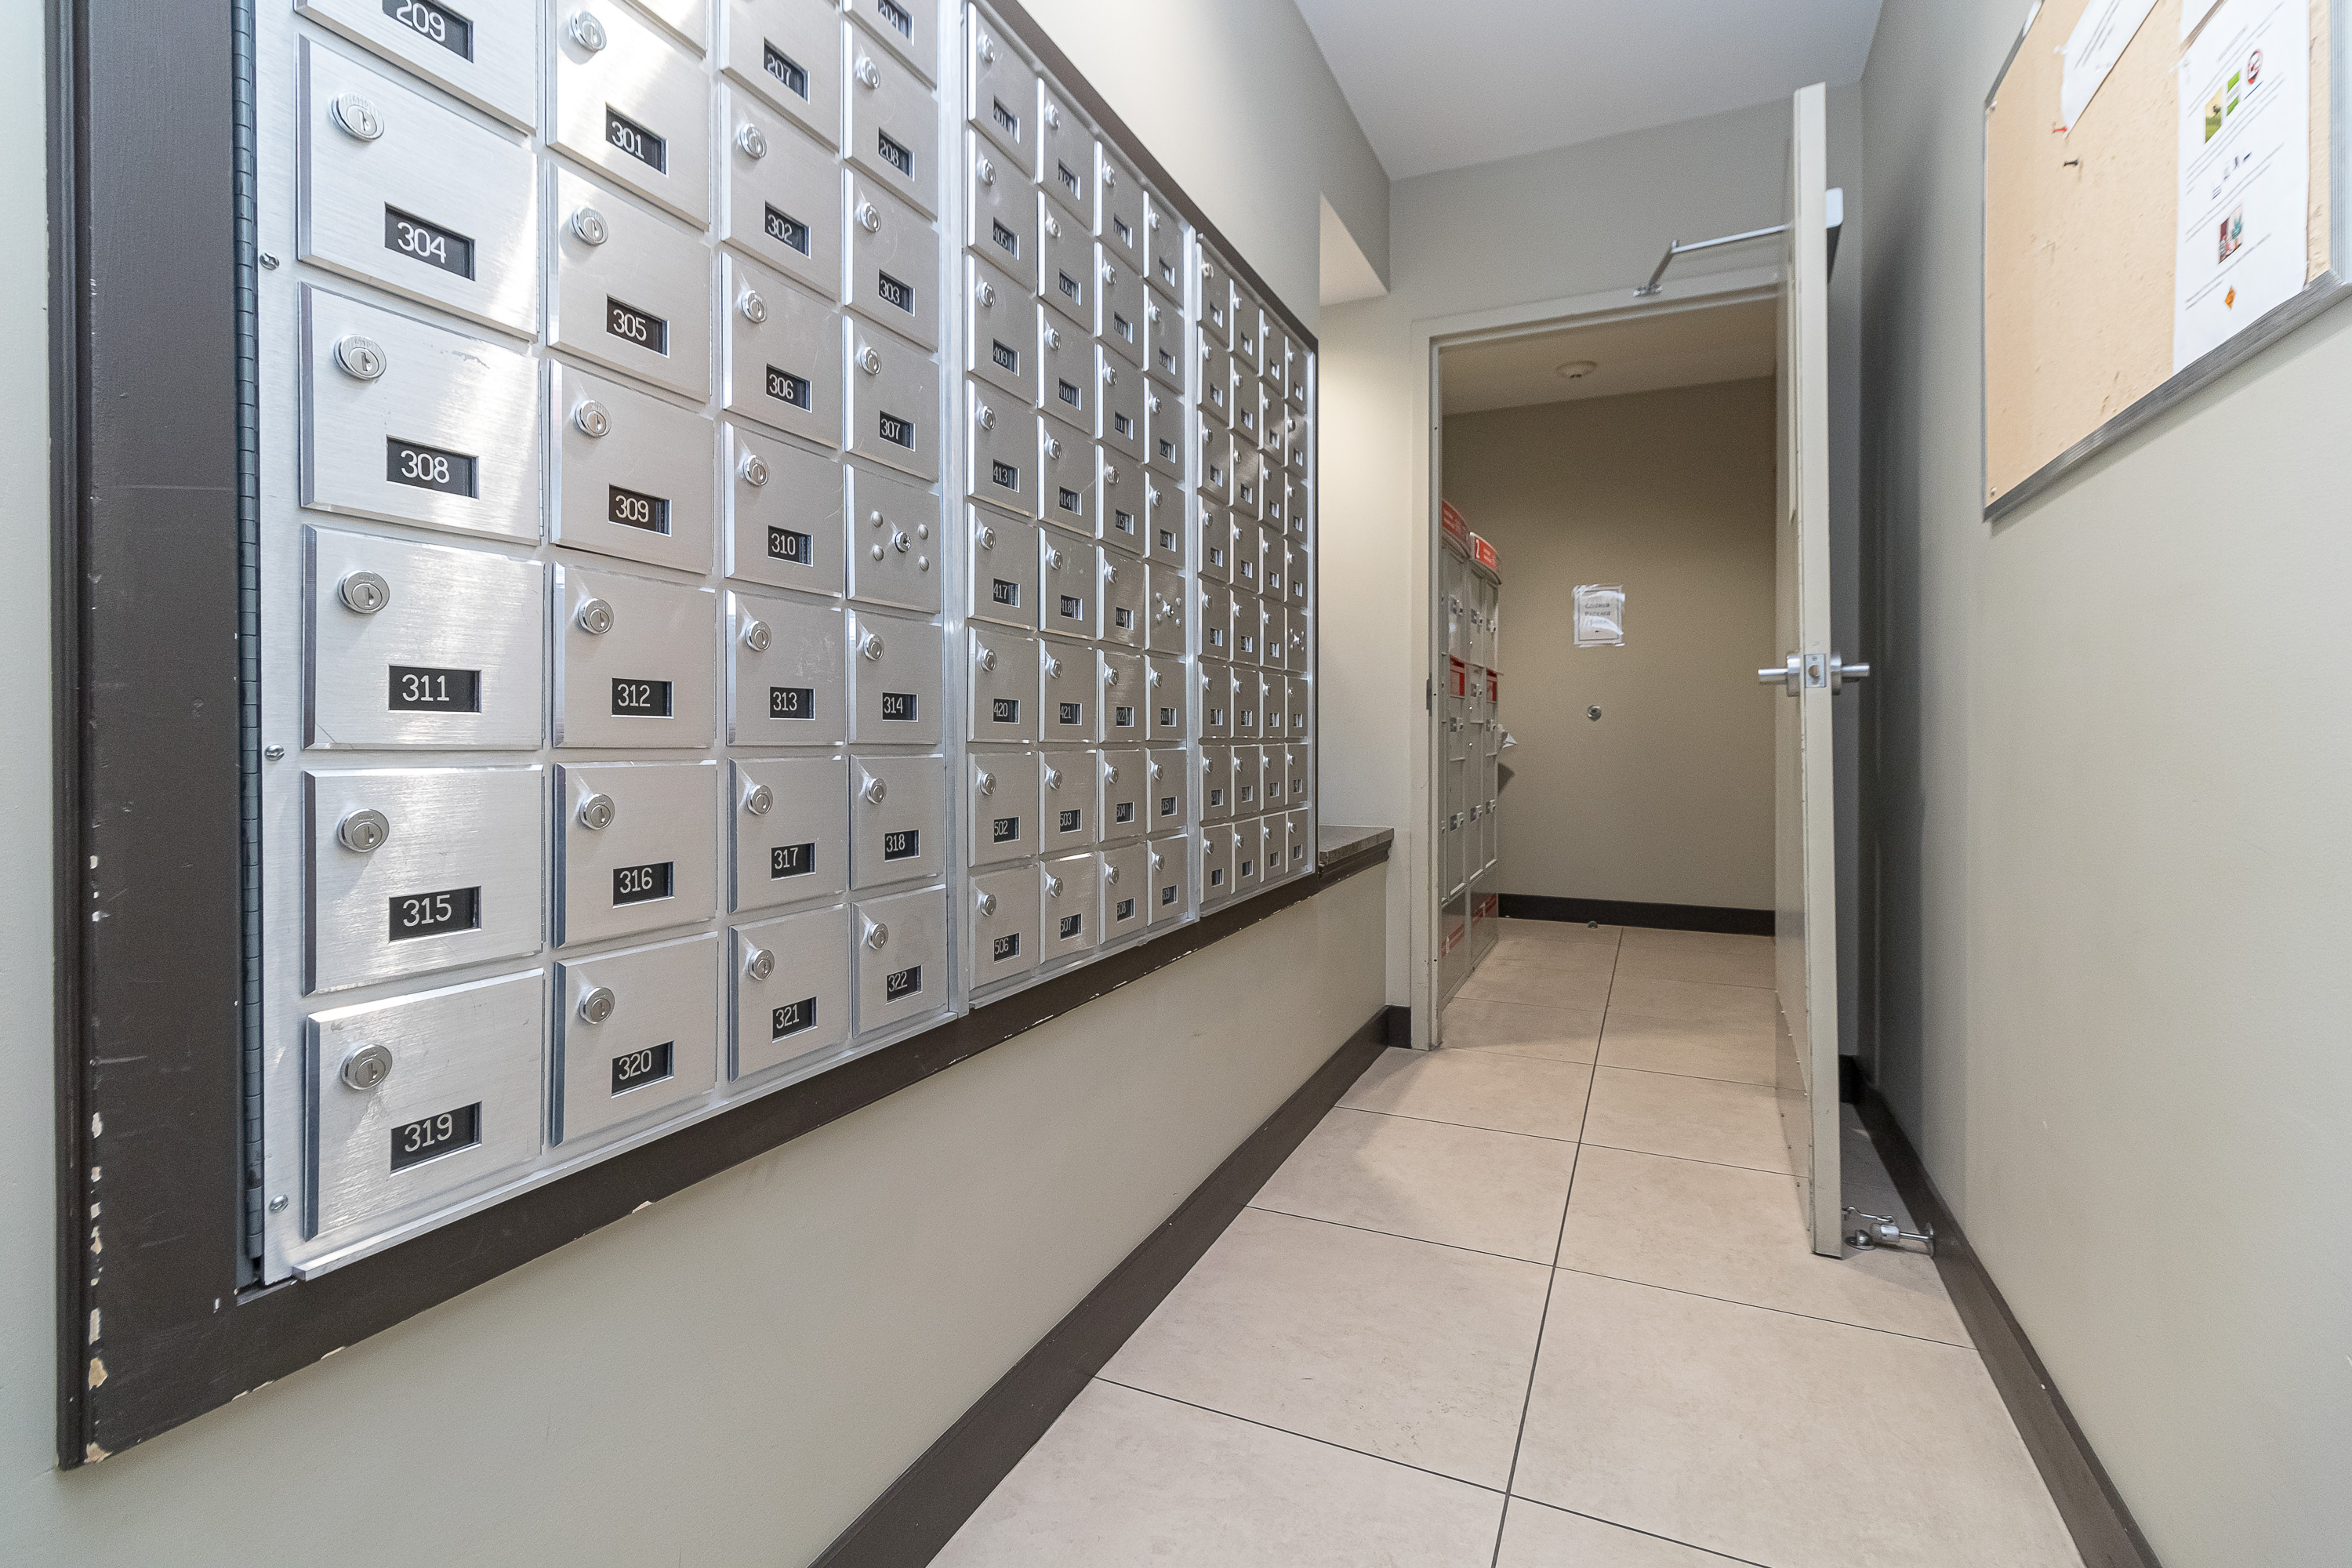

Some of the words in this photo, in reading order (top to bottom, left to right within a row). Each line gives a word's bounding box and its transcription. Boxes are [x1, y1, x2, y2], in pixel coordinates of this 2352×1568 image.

[396, 0, 445, 42] 209
[767, 53, 792, 87] 207
[612, 122, 644, 160] 301
[880, 140, 899, 166] 208
[768, 214, 793, 245] 302
[993, 227, 1007, 249] 405
[397, 222, 447, 264] 304
[880, 279, 900, 304] 303
[613, 310, 647, 341] 305
[993, 347, 1007, 365] 409
[769, 374, 793, 400] 306
[880, 418, 901, 440] 307
[401, 450, 451, 484] 308
[993, 466, 1007, 483] 413
[615, 495, 649, 523] 309
[771, 533, 796, 556] 310
[993, 583, 1007, 600] 417
[402, 674, 450, 701] 311
[618, 684, 651, 707] 312
[773, 691, 797, 711] 313
[884, 696, 903, 713] 314
[994, 702, 1007, 717] 420
[1060, 706, 1072, 718] 421
[994, 821, 1007, 836] 502
[1060, 813, 1072, 826] 503
[886, 833, 906, 852] 318
[774, 848, 798, 869] 317
[619, 867, 652, 894] 316
[402, 895, 452, 927] 315
[1060, 917, 1072, 933] 507
[994, 938, 1008, 954] 506
[887, 971, 908, 993] 322
[776, 1004, 800, 1029] 321
[619, 1050, 652, 1080] 320
[405, 1113, 453, 1152] 319
